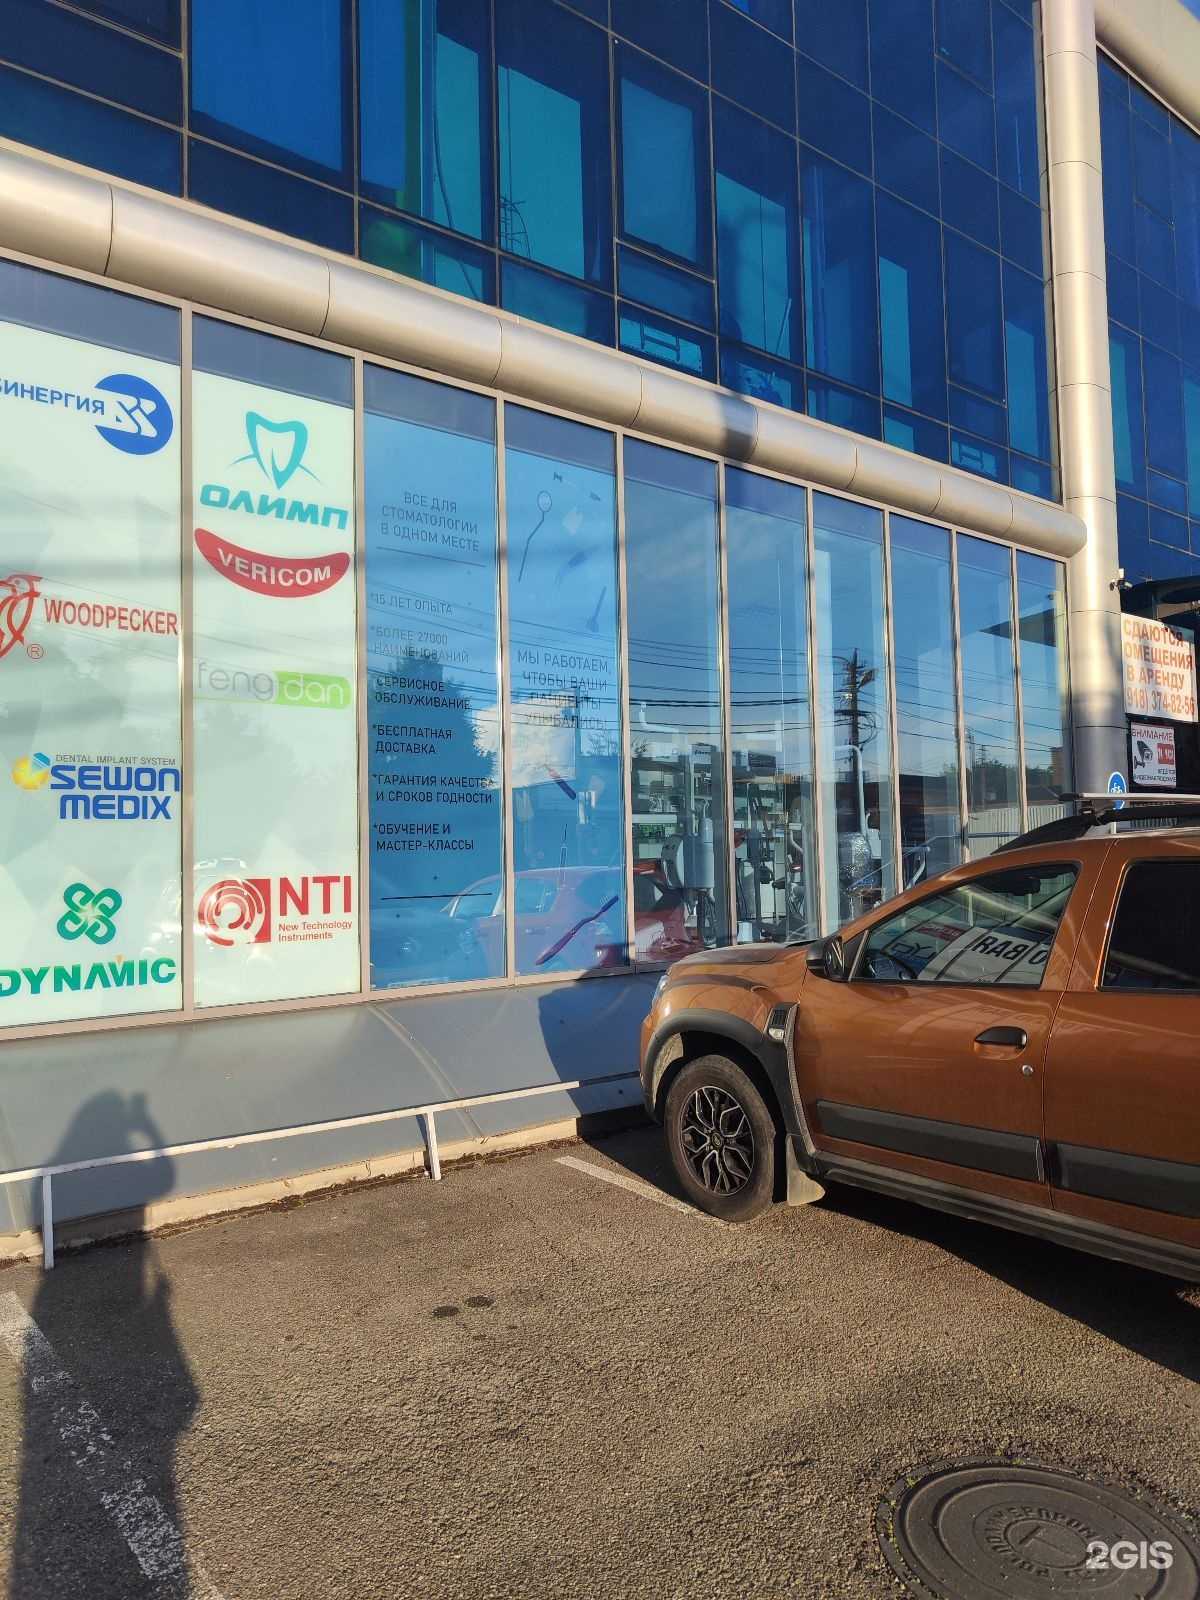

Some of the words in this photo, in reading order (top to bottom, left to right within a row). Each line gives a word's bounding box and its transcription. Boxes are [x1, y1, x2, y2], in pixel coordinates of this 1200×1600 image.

[200, 484, 348, 530] ОЛИМП
[404, 491, 428, 507] ВСЕ
[430, 497, 457, 513] ДЛЯ
[382, 505, 478, 535] СТОМАТОЛОГИИ
[381, 522, 389, 535] В
[393, 525, 438, 544] ОДНОМ
[441, 534, 480, 552] МЕСТЕ
[217, 548, 331, 587] VERICOM
[389, 595, 411, 608] ЛЕТ
[415, 599, 453, 613] ОПЫТА
[43, 598, 178, 636] WOODPECKER
[418, 631, 448, 646] 27000
[1124, 619, 1184, 647] СДАЮТСЯ
[518, 649, 539, 665] МЫ
[1125, 642, 1193, 672] ОМЕЩЕНИЯ
[523, 671, 566, 688] ЧТОБЫ
[570, 675, 607, 693] ВАШИ
[1127, 664, 1135, 682] В
[1139, 667, 1184, 690] АРЕНДУ
[375, 692, 472, 710] ОБСЛУЖИВАНИЕ
[1132, 729, 1173, 741] ВНИМАНИЕ
[375, 741, 437, 755] ДОСТАВКА
[56, 754, 95, 763] DENTAL
[97, 755, 137, 765] IMPLANT
[140, 757, 176, 766] SYSTEM
[50, 764, 181, 792] SEWON
[440, 776, 494, 788] КАЧЕСТВА
[59, 794, 172, 820] MEDIX
[376, 791, 384, 801] И
[388, 790, 433, 801] СРОКОВ
[436, 791, 492, 804] ГОДНОСТИ
[442, 823, 451, 834] И
[376, 839, 474, 852] МАСТЕР-КЛАССЫ
[279, 875, 352, 917] NTI
[278, 923, 299, 932] New
[302, 920, 353, 931] Technology
[278, 931, 333, 942] Instruments
[0, 957, 177, 998] DYNAMIC
